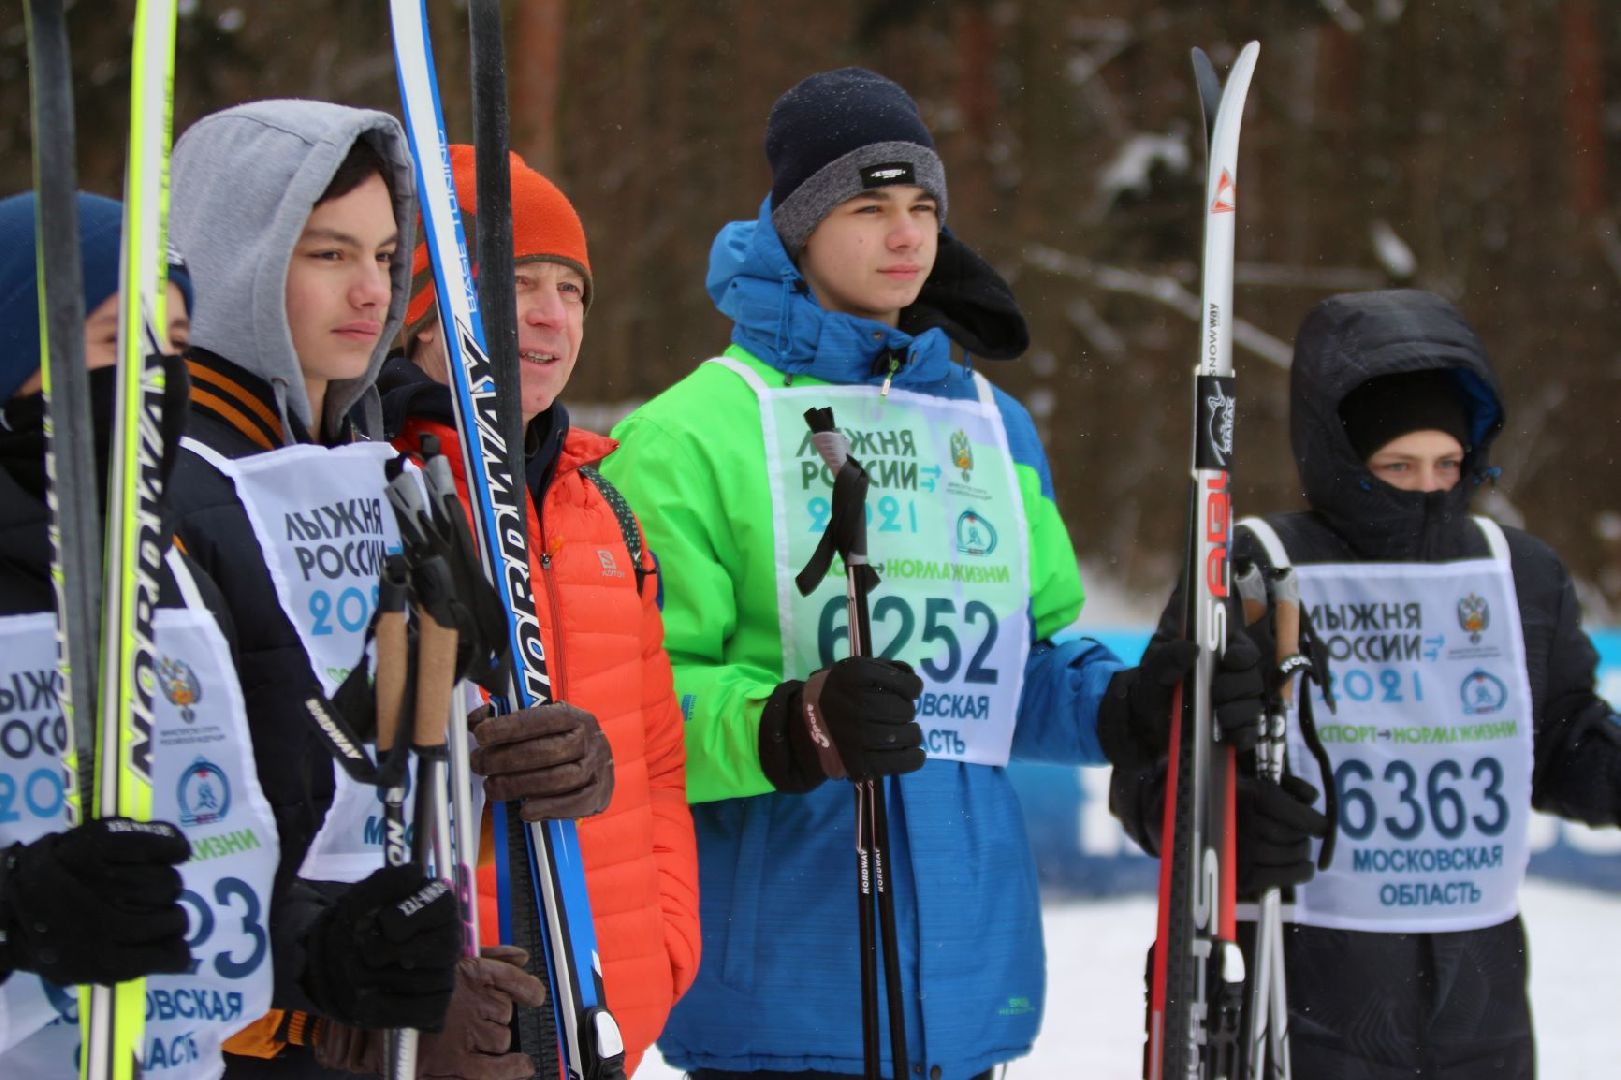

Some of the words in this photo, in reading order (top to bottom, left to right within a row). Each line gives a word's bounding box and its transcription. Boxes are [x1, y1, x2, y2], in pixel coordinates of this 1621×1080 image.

[795, 427, 917, 457] ЛЖНЯ
[801, 460, 918, 491] РОСИИ
[285, 498, 383, 541] ЛЫЖНЯ
[807, 496, 917, 533] 221
[1328, 635, 1421, 663] ОССИИ
[1335, 757, 1510, 841] 6363
[191, 828, 262, 863] ИЗНИ
[1353, 846, 1503, 872] МОСКОВСКАЯ
[1379, 882, 1481, 906] ОБЛАСТЬ
